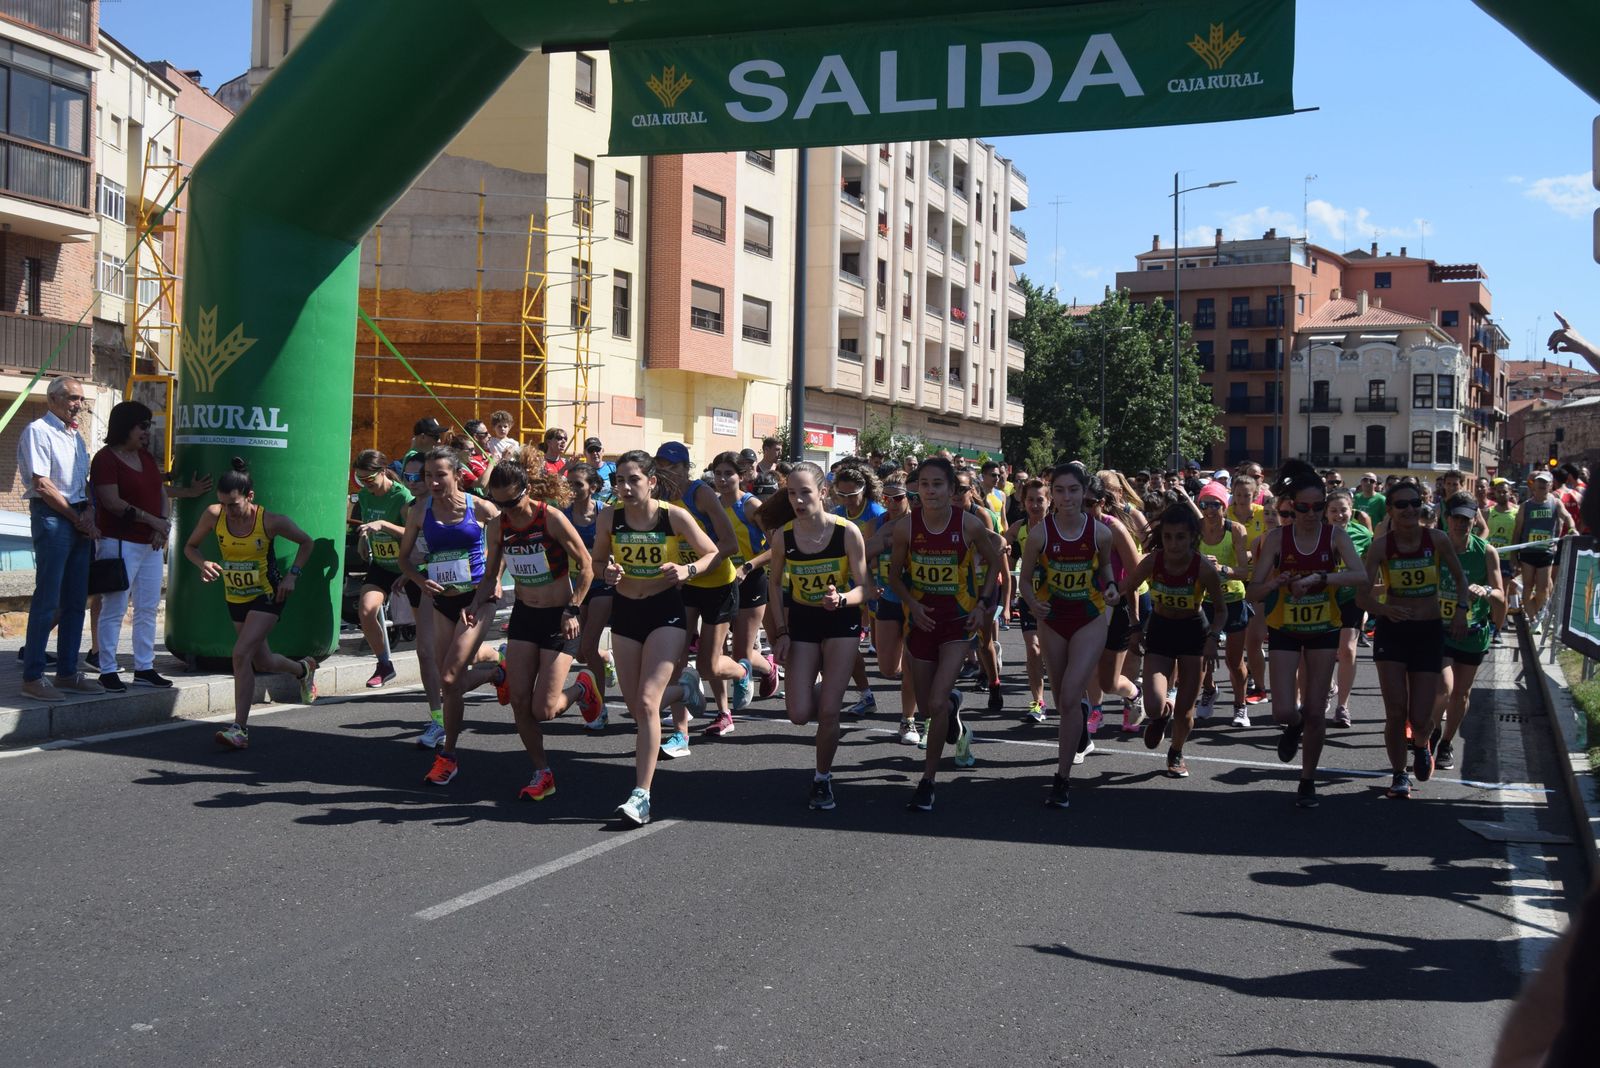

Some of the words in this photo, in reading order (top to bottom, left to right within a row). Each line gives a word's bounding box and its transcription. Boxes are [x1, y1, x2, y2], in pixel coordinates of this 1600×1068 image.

[725, 33, 1145, 123] SALIDA
[1167, 78, 1206, 93] CAJA
[1207, 72, 1264, 89] RURAL
[631, 113, 660, 127] CAJA
[662, 111, 707, 125] RURAL
[248, 438, 278, 446] ZAMORA
[375, 543, 395, 556] 184
[504, 543, 546, 555] KENYA
[621, 546, 662, 564] 248
[436, 568, 457, 583] MARÍA
[513, 563, 538, 575] MARTA
[916, 566, 953, 582] 402
[226, 572, 254, 587] 160
[799, 574, 837, 591] 244
[1052, 572, 1086, 589] 404
[1401, 570, 1425, 586] 39
[1155, 594, 1188, 608] 136
[1290, 604, 1324, 622] 107
